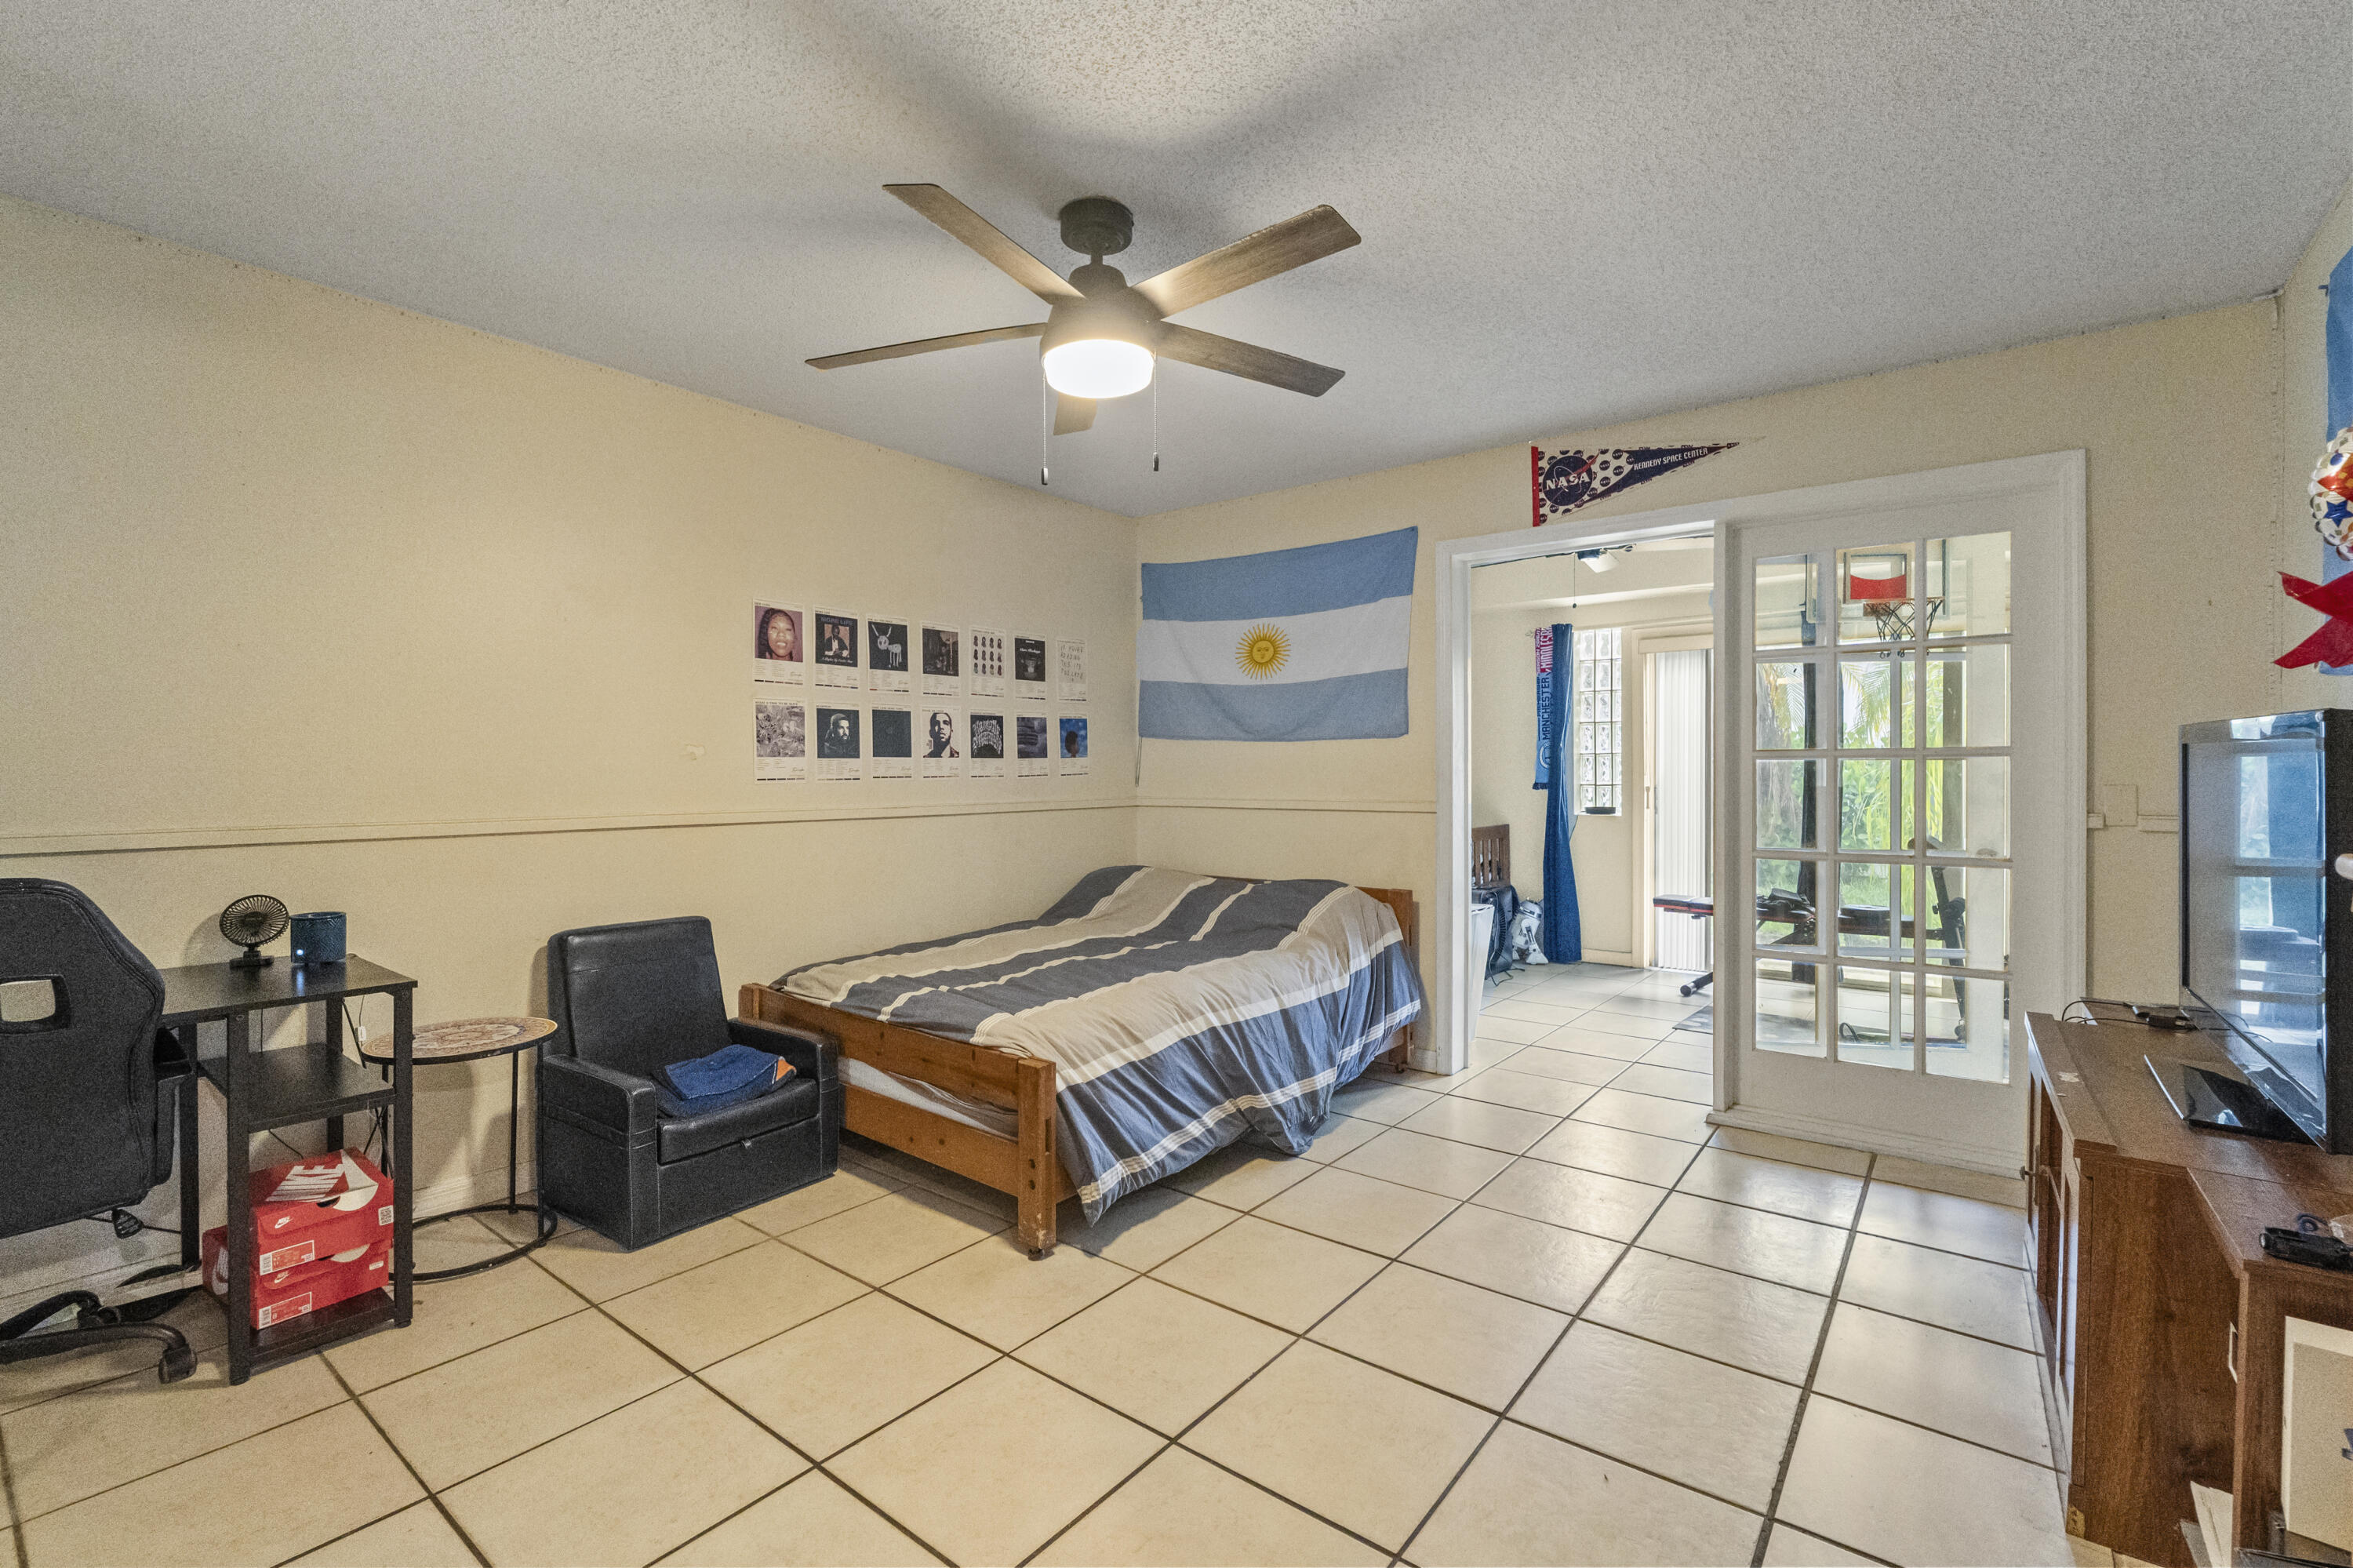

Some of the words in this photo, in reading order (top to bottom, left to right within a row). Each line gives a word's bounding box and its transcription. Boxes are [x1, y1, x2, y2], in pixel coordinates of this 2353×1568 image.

[1634, 457, 1662, 471] KENNEDY
[1662, 453, 1682, 464] SPACE
[1683, 447, 1708, 460] CENTER
[1546, 472, 1590, 490] NASA
[1540, 677, 1551, 740] MANCHESTER
